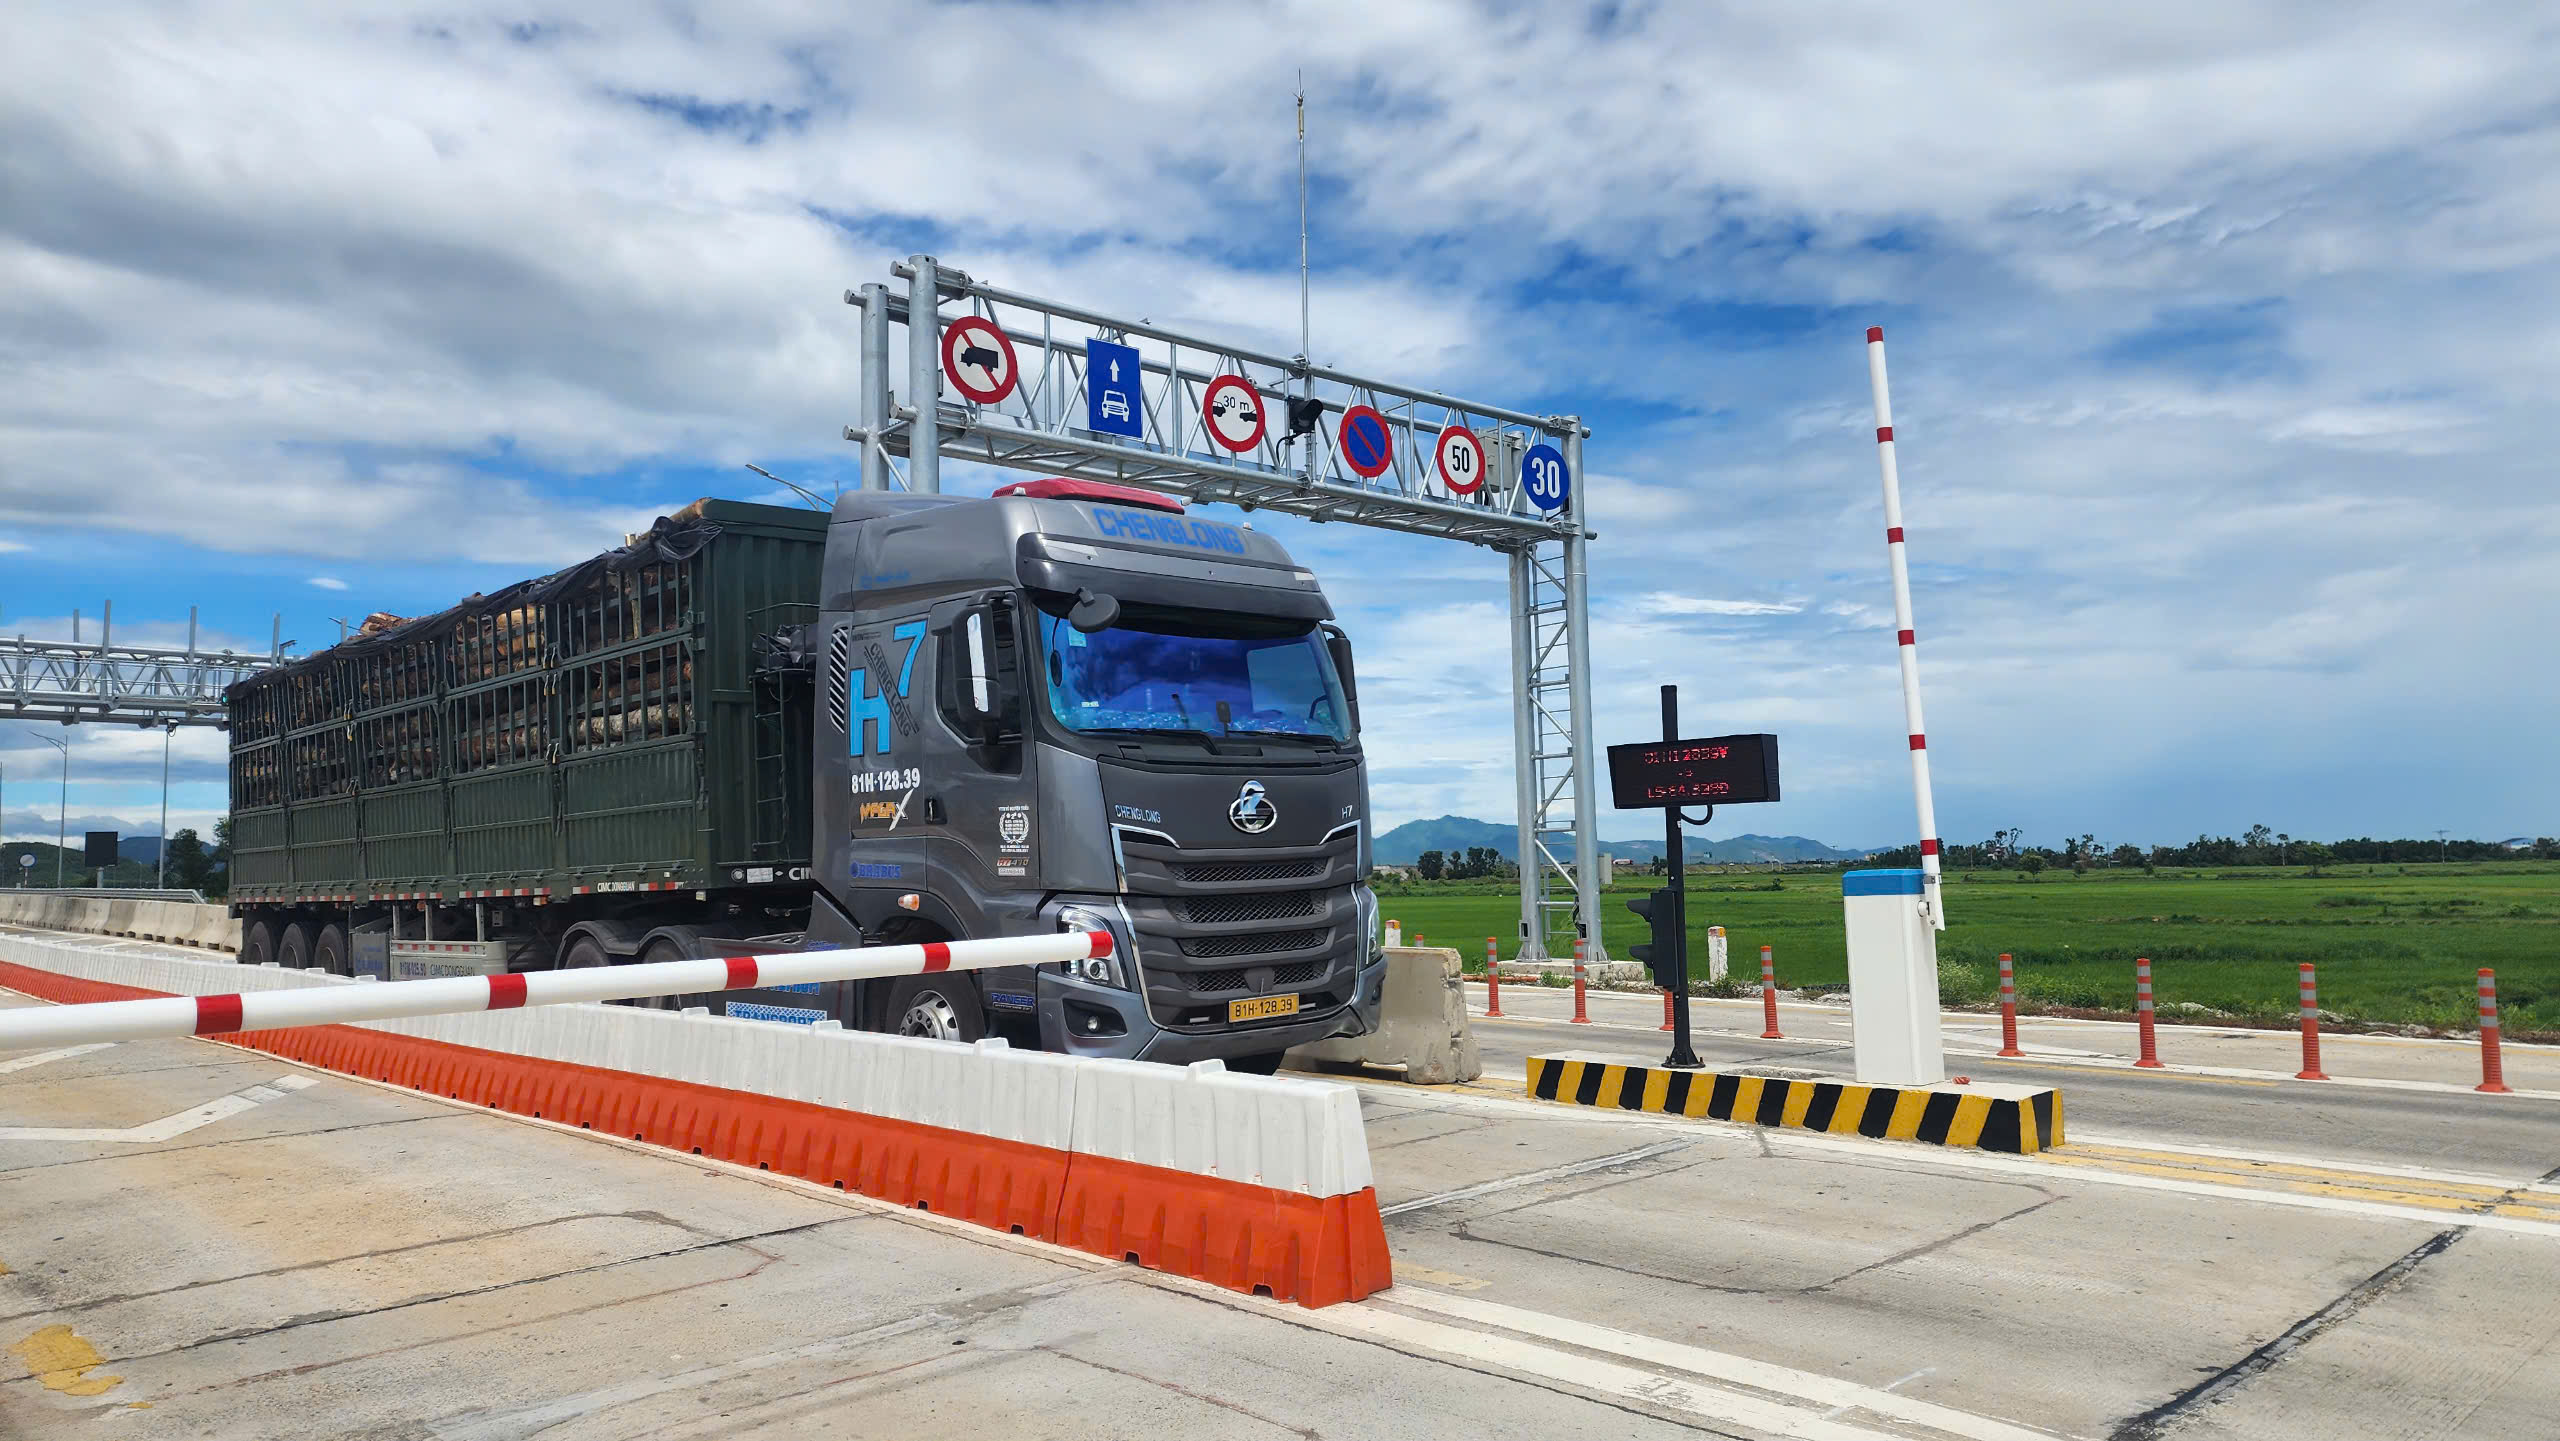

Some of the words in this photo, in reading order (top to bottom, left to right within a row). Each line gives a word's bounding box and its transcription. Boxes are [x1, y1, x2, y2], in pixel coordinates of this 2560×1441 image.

[1223, 395, 1236, 408] 30
[1239, 401, 1250, 411] m
[1452, 445, 1470, 473] 50
[1531, 457, 1560, 498] 30
[1092, 508, 1245, 554] CHENGLONG
[870, 642, 893, 693] CHENG
[890, 693, 912, 737] LONG
[851, 767, 921, 794] 81H-128.39
[1114, 804, 1161, 824] CHENGLONG
[1341, 804, 1353, 819] H7
[860, 864, 901, 878] BRABUS
[1235, 998, 1293, 1017] 81H-128.39
